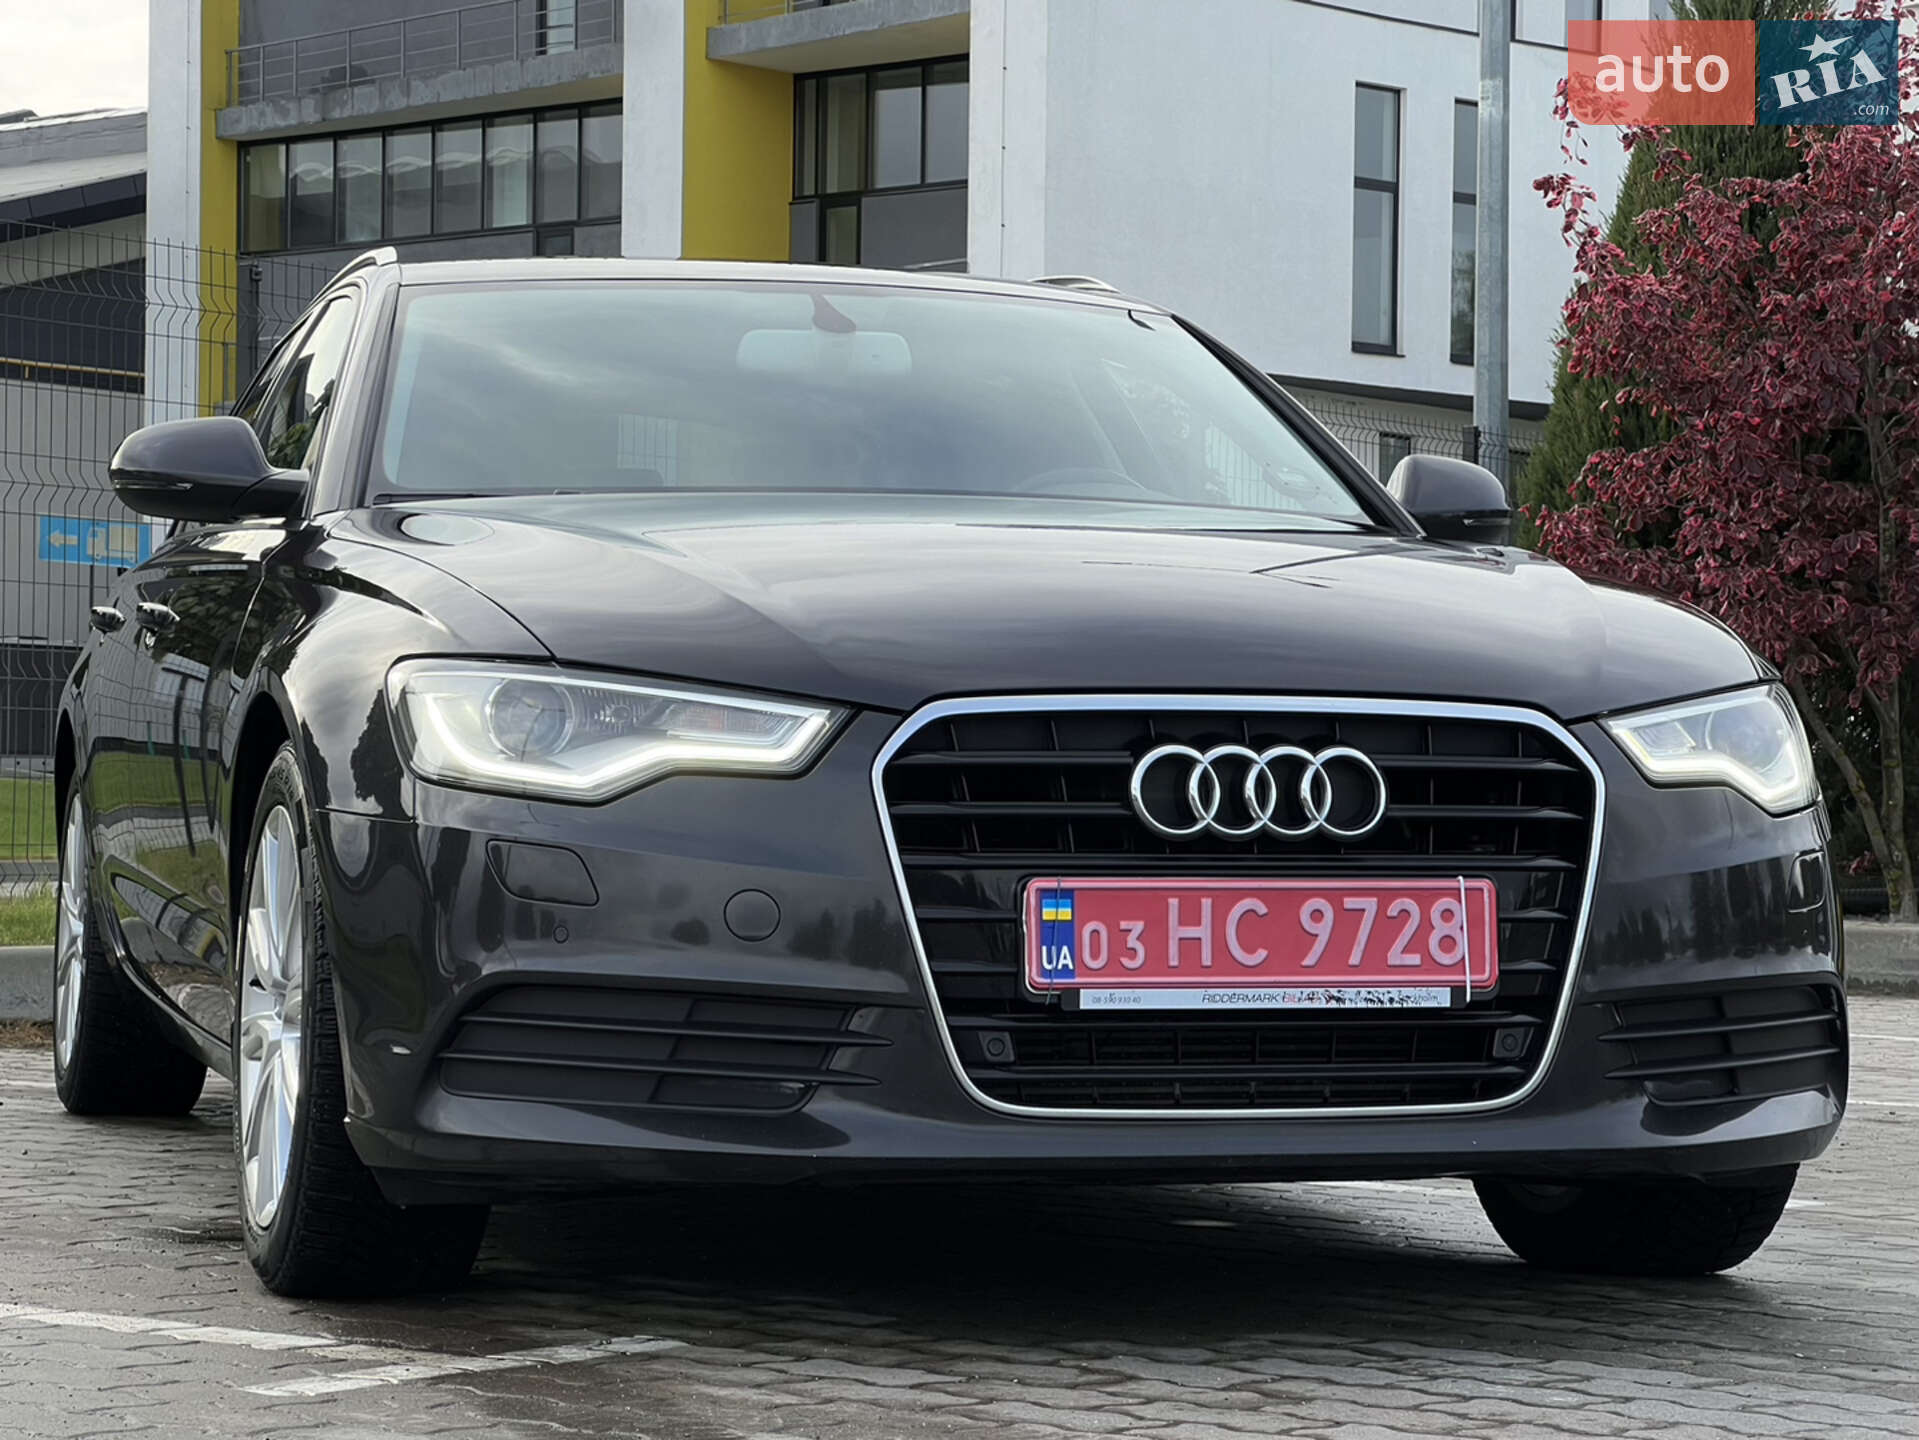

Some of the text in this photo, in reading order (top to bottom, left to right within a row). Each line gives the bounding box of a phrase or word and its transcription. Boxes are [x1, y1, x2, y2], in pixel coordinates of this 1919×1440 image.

[1081, 897, 1465, 969] 03 HC 9728
[1041, 945, 1075, 970] UA
[1201, 992, 1280, 1004] RIDDERMARK
